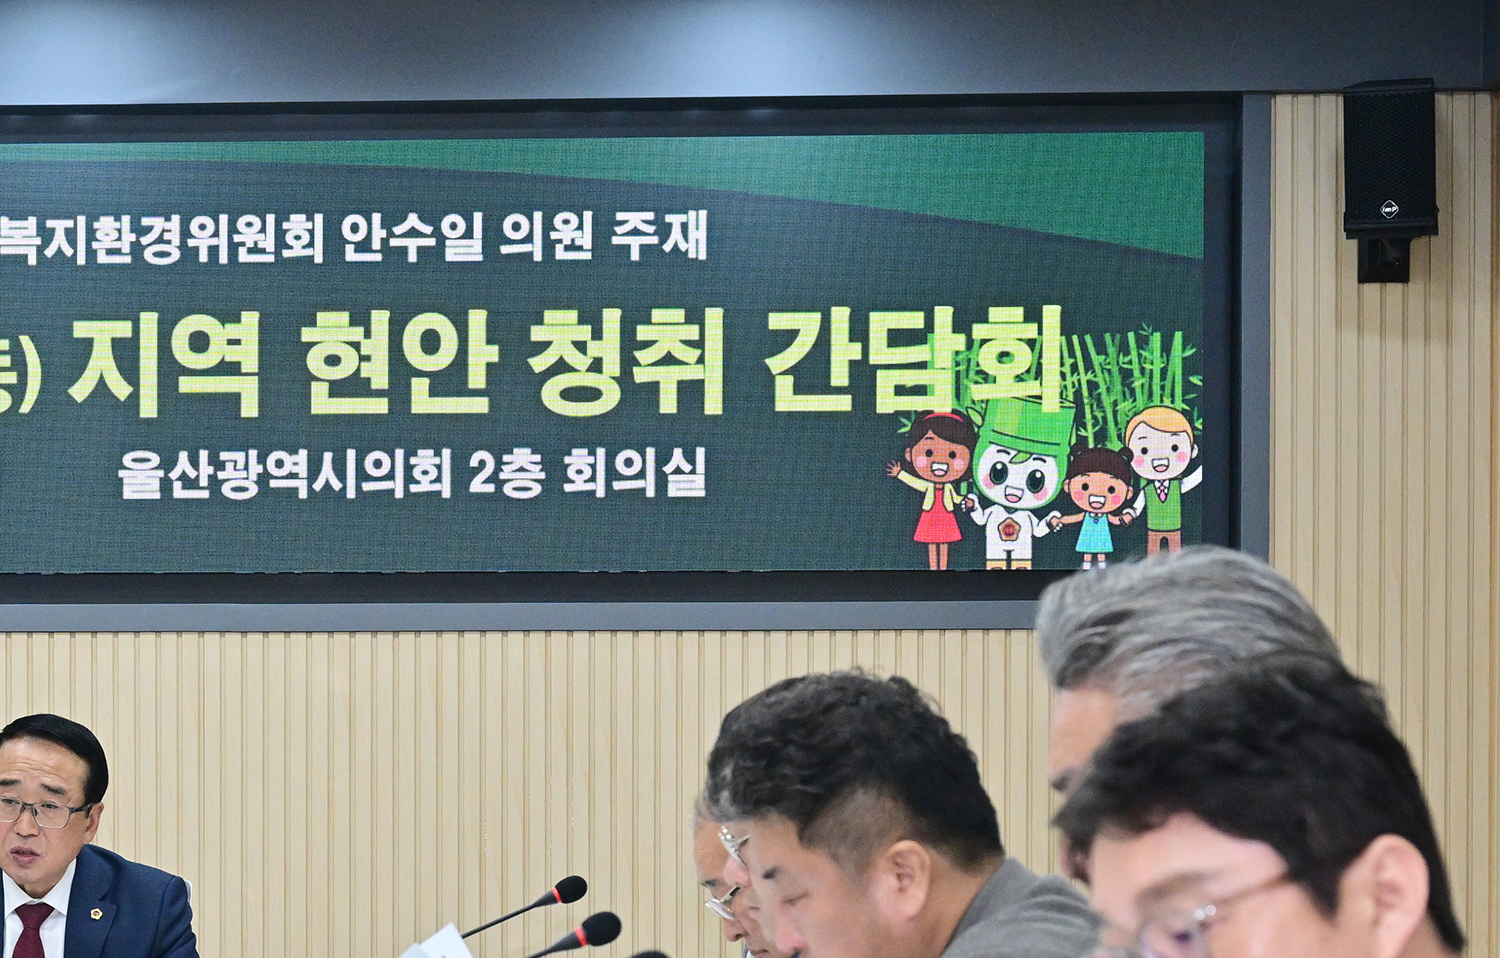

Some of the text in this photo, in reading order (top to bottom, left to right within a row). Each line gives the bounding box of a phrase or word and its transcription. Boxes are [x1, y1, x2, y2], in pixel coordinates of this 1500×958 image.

[342, 212, 485, 264] 안수일
[500, 211, 594, 263] 의원
[612, 210, 709, 262] 주재
[68, 311, 261, 419] 지역
[301, 310, 501, 416] 현안
[528, 308, 725, 418] 청취
[765, 305, 1062, 415] 간담회
[119, 447, 707, 502] 울산광역시의회 2층 회의실
